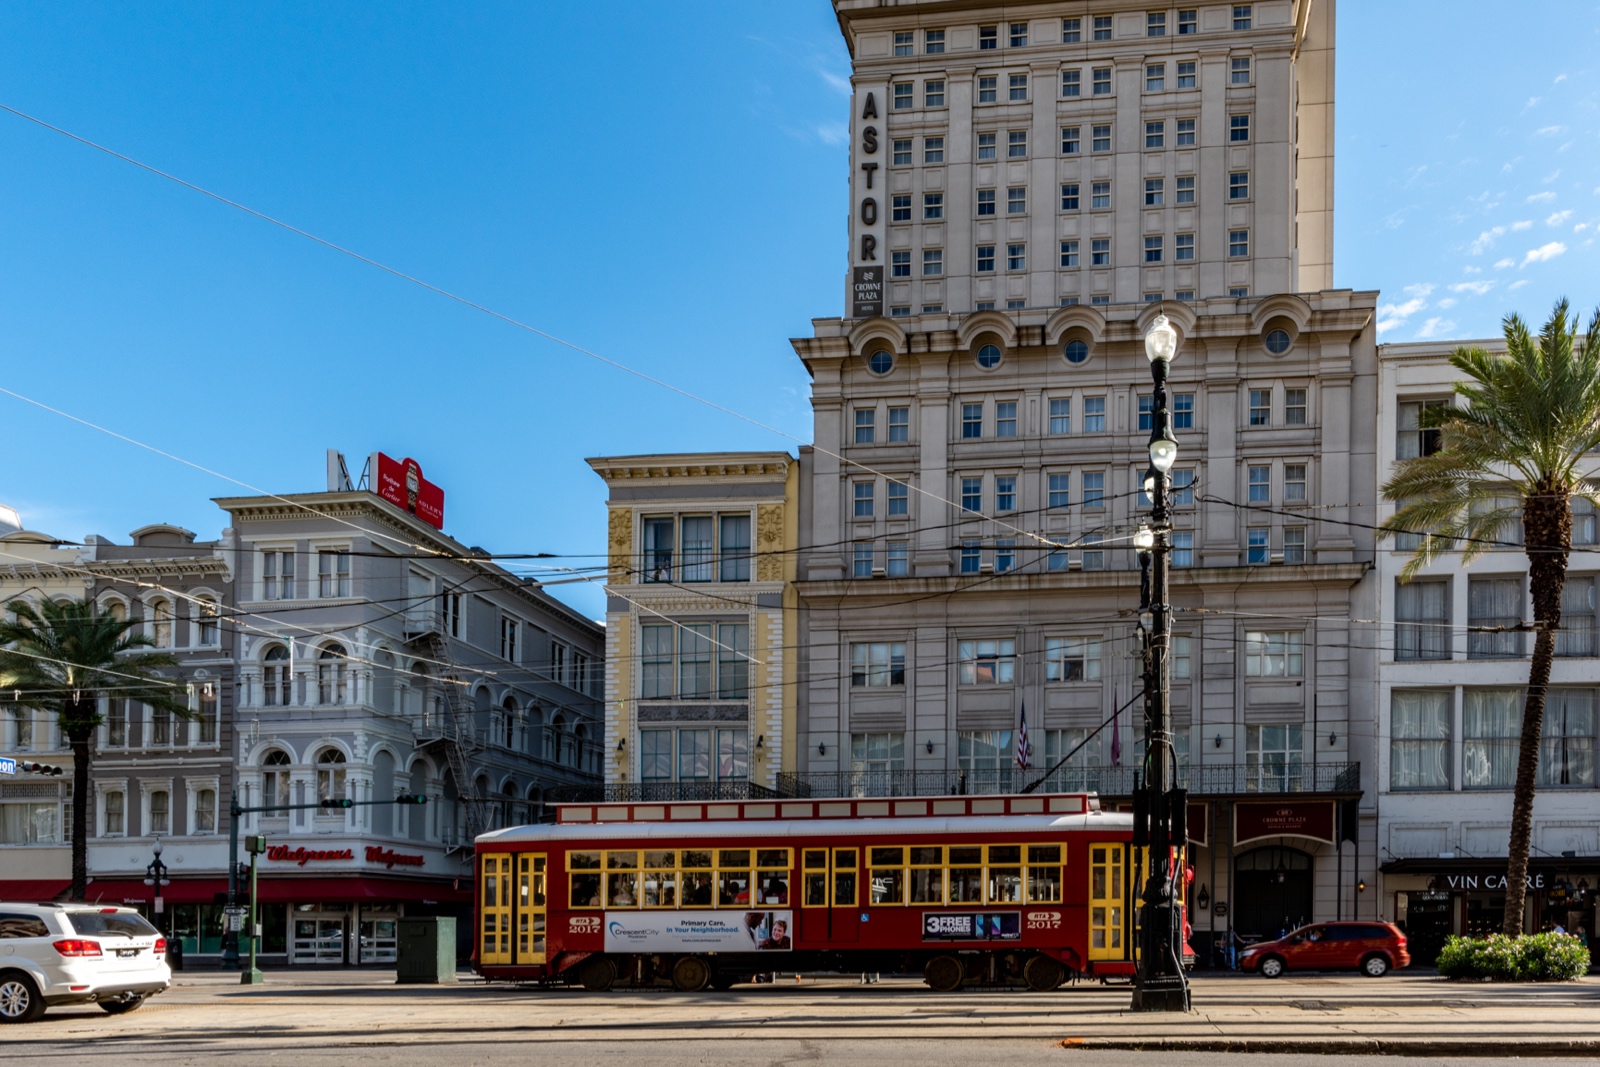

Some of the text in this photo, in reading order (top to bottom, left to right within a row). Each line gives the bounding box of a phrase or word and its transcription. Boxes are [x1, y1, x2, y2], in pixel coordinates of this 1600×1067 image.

[861, 92, 878, 261] ASTOR
[855, 283, 881, 291] CROWNE
[858, 292, 878, 300] PLAZA
[382, 488, 400, 502] Cartier
[0, 761, 14, 773] on
[266, 844, 354, 866] Walgreens
[364, 846, 426, 869] Walgreens
[1447, 874, 1545, 889] VIN CARÉ
[569, 925, 600, 934] 2017
[927, 917, 971, 933] 3 FREE
